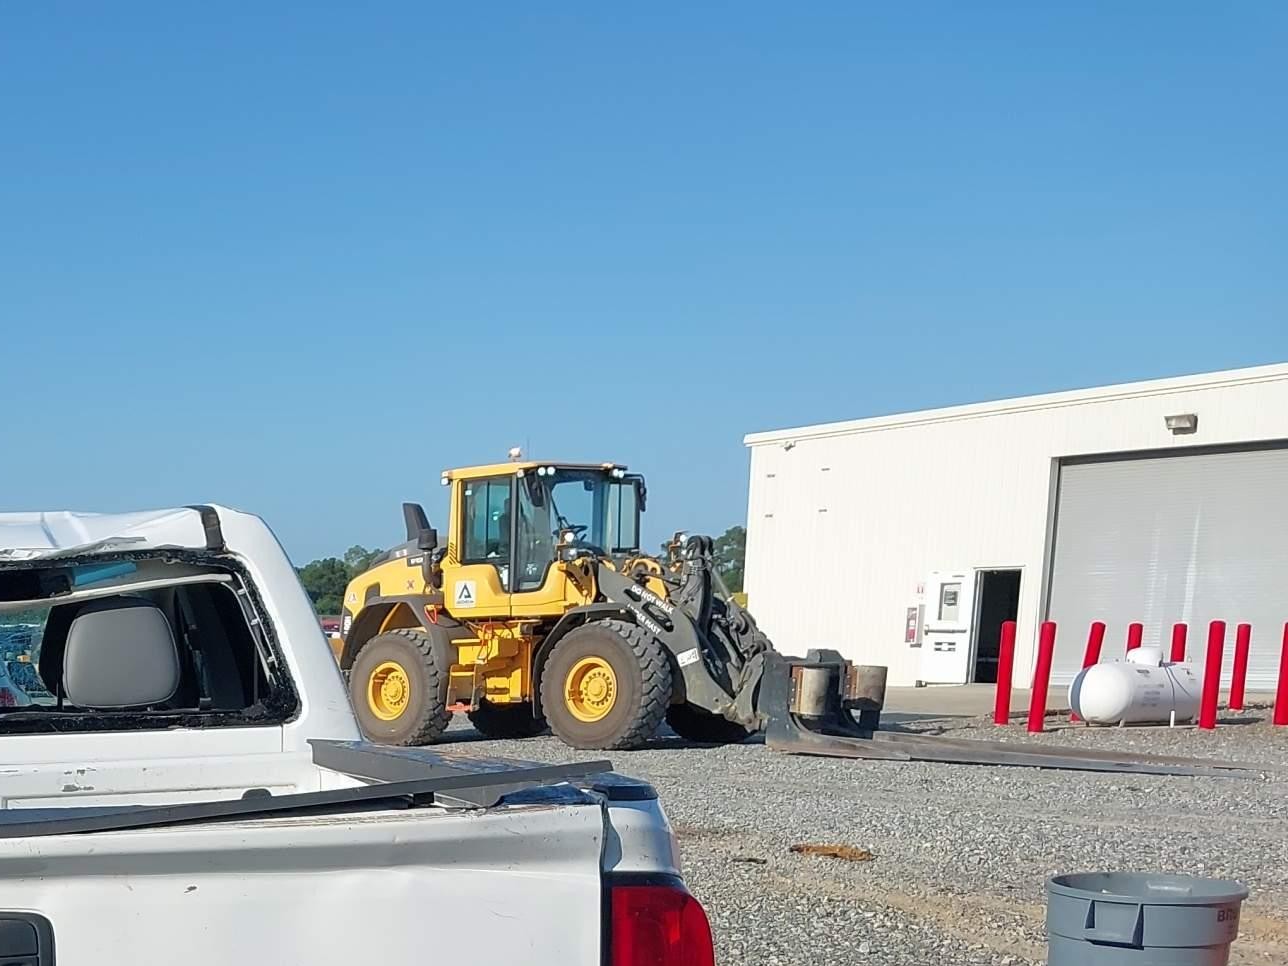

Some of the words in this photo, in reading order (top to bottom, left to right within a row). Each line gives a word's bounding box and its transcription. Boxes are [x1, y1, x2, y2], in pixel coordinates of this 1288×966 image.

[632, 585, 642, 595] DO
[641, 591, 656, 602] NOT
[655, 600, 674, 615] WALK
[645, 619, 661, 635] MAST
